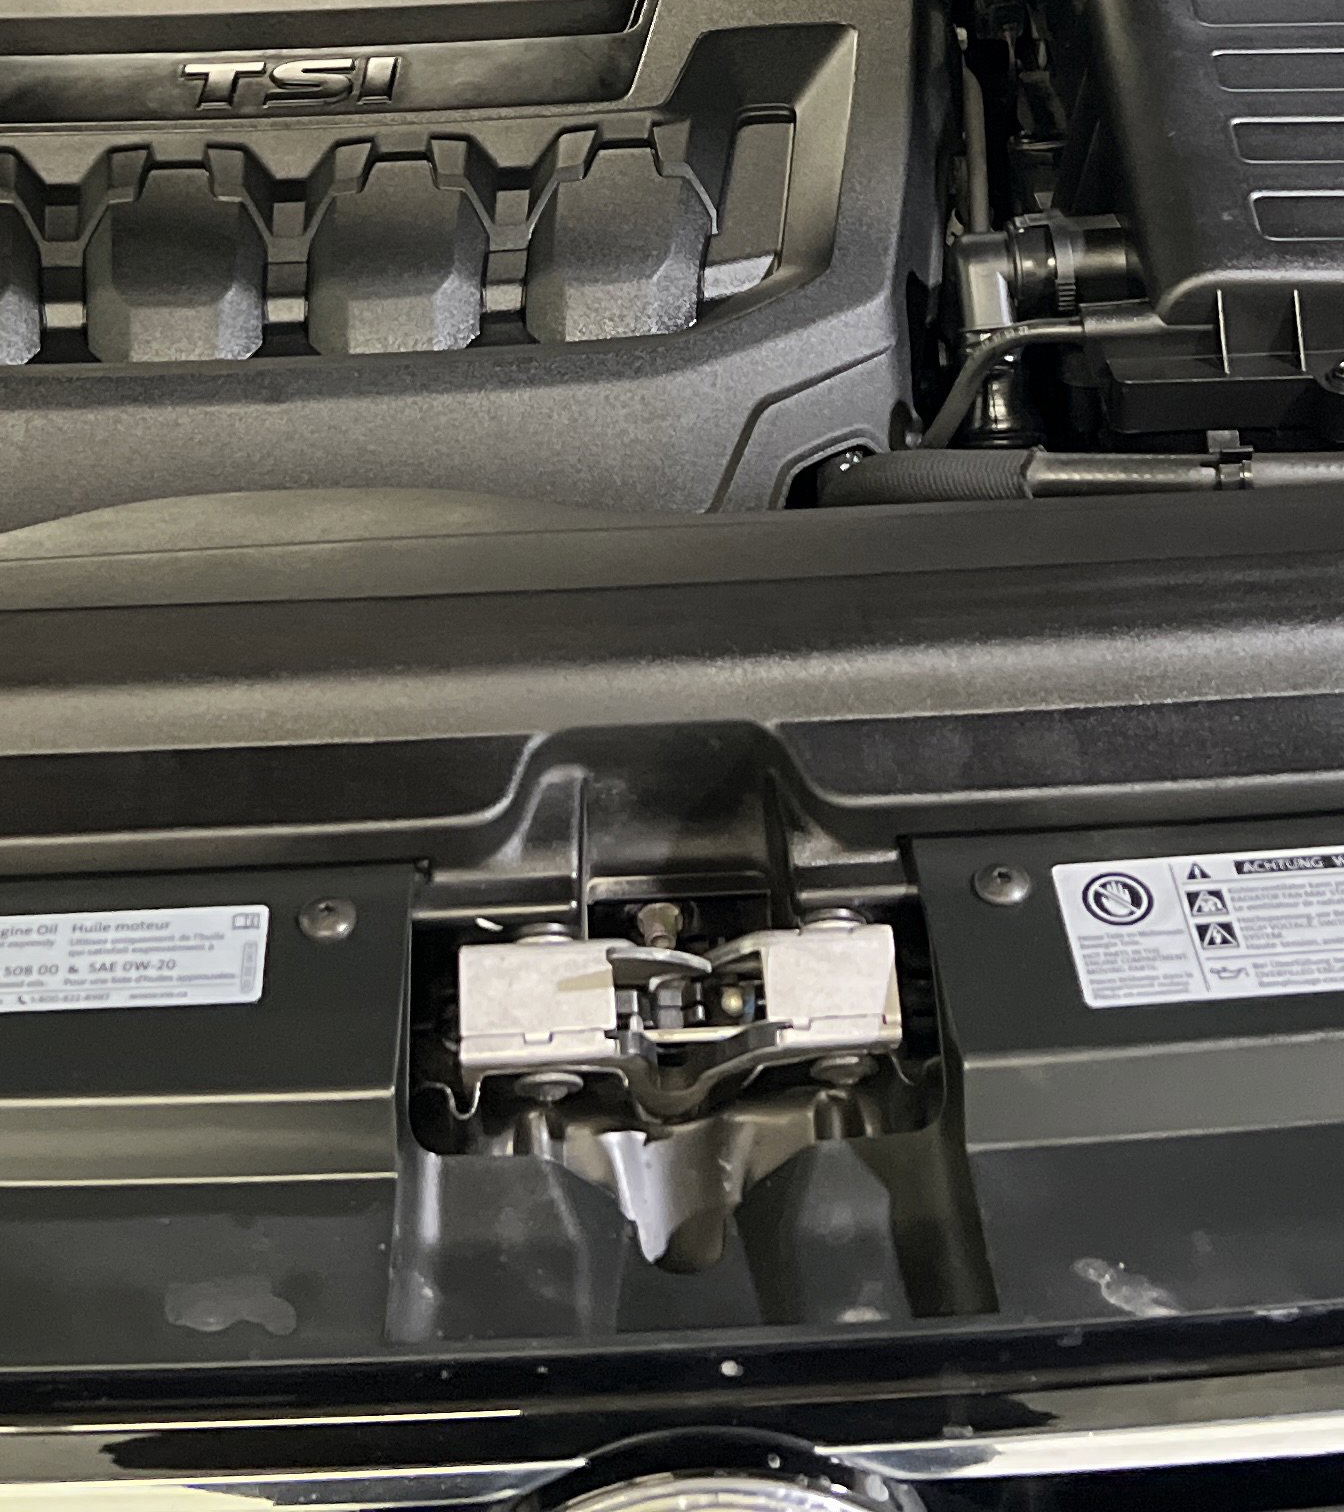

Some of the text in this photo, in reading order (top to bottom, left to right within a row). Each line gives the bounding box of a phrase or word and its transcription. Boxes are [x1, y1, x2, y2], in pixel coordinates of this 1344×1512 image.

[180, 55, 402, 111] TSI
[1242, 856, 1324, 872] ACHTUNG
[36, 923, 58, 935] Oil
[71, 921, 111, 933] Huile
[115, 920, 171, 932] moteur
[3, 965, 34, 977] 508
[38, 963, 60, 975] 00
[68, 965, 79, 974] &
[88, 960, 117, 974] SAE
